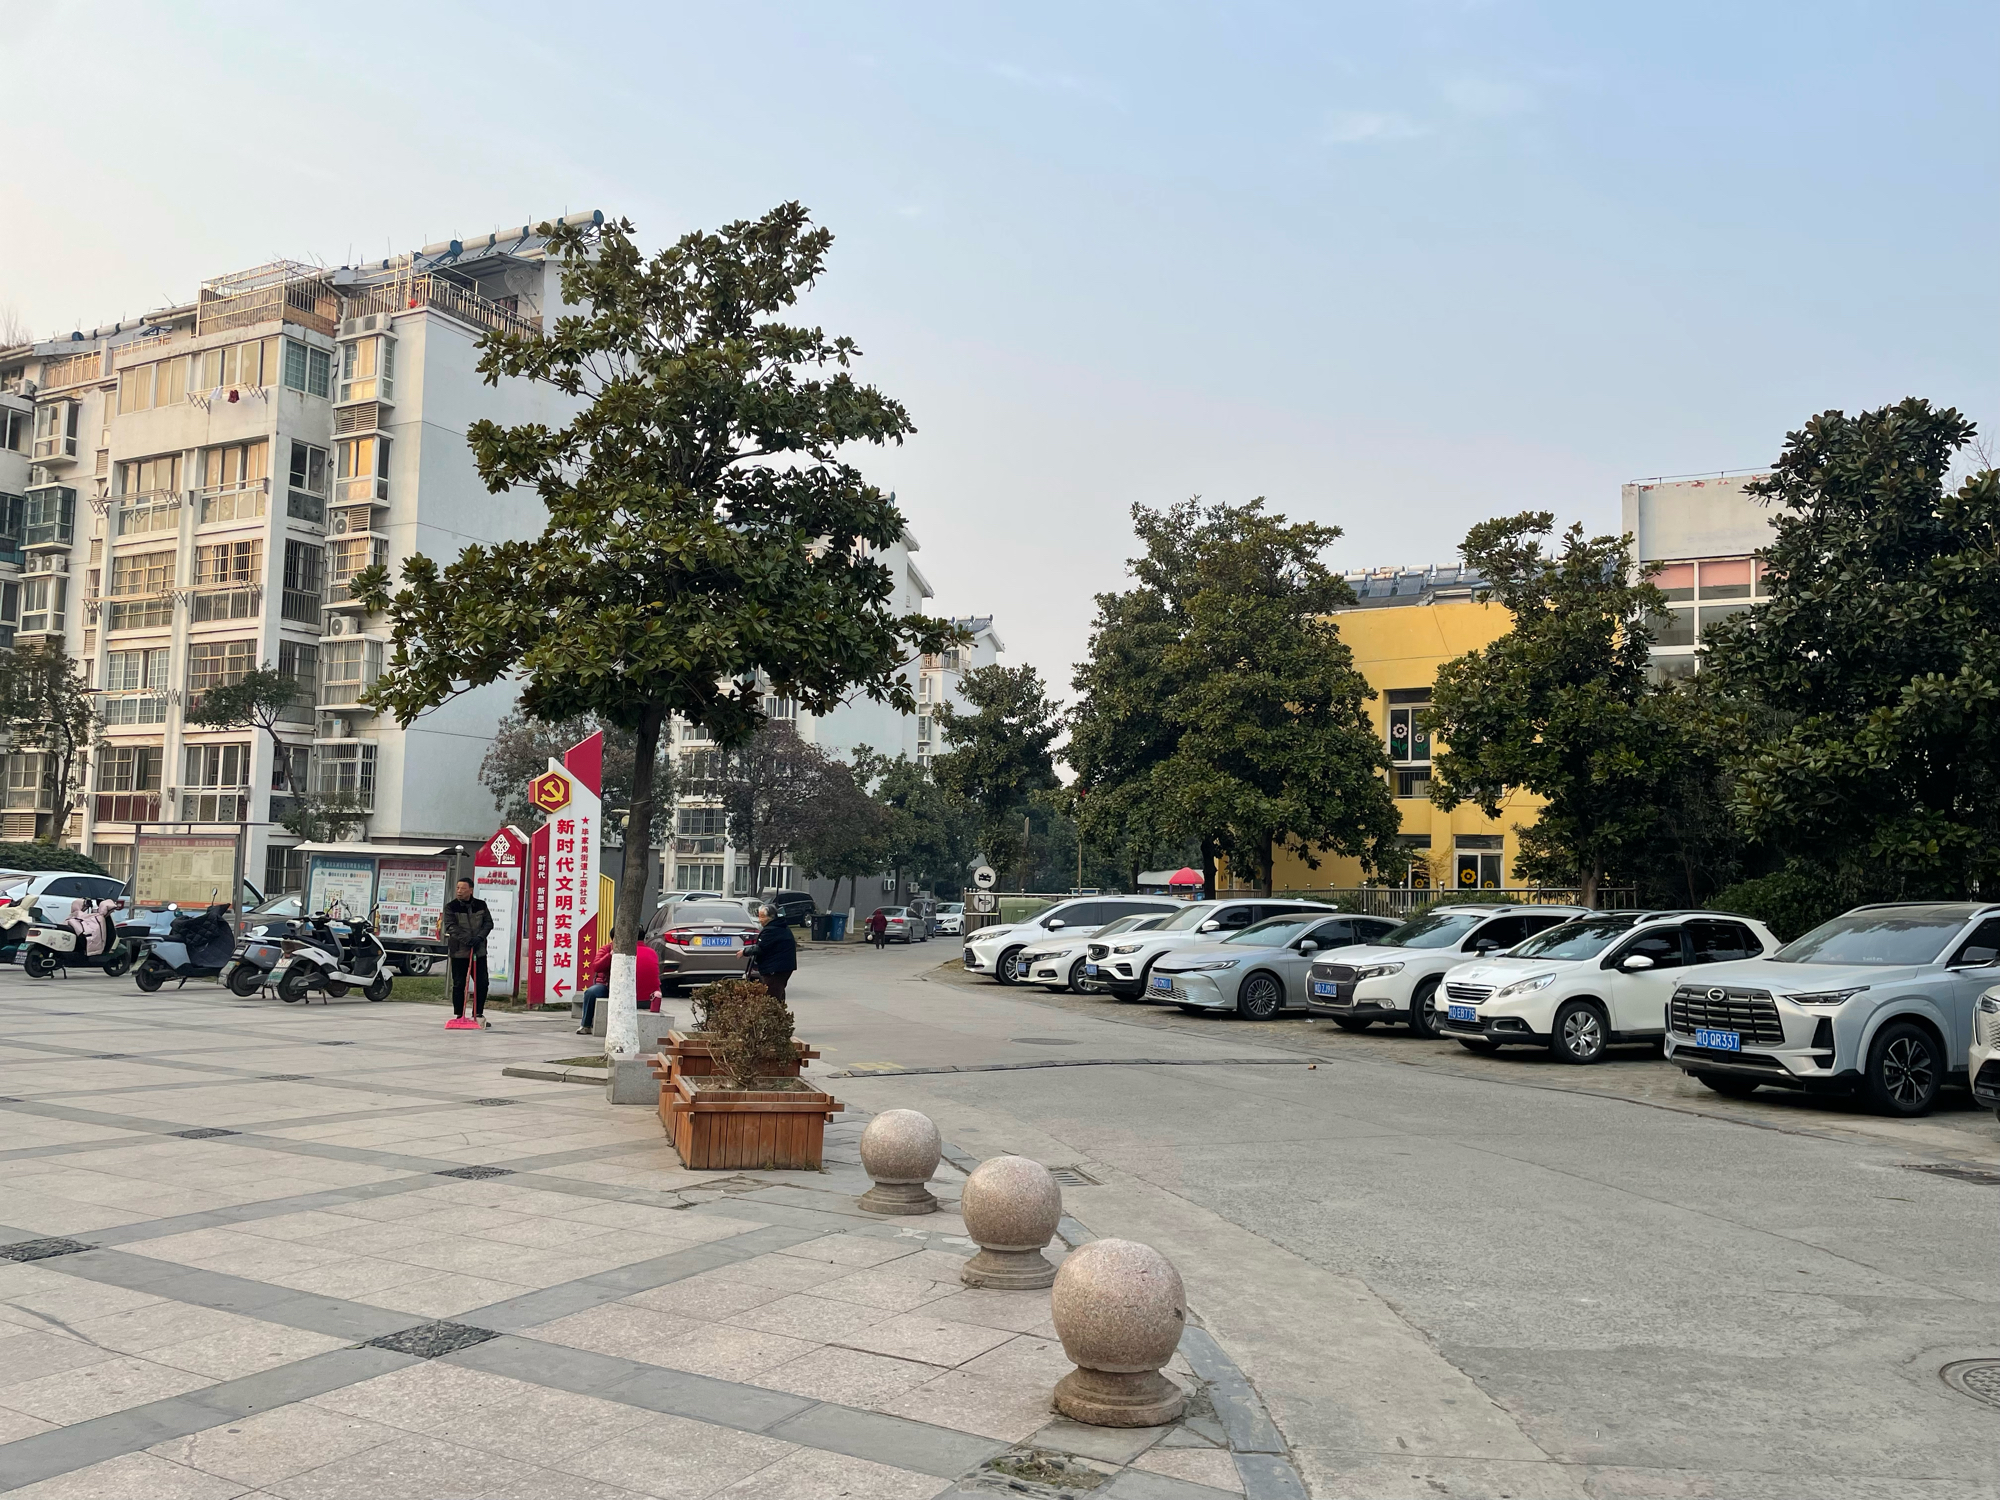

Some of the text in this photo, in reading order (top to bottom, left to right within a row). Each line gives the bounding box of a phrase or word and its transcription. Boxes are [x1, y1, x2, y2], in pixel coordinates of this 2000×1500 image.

[535, 855, 546, 974] 新时代 新思想 新目标 新征程
[553, 818, 575, 968] 新时代文明实践站
